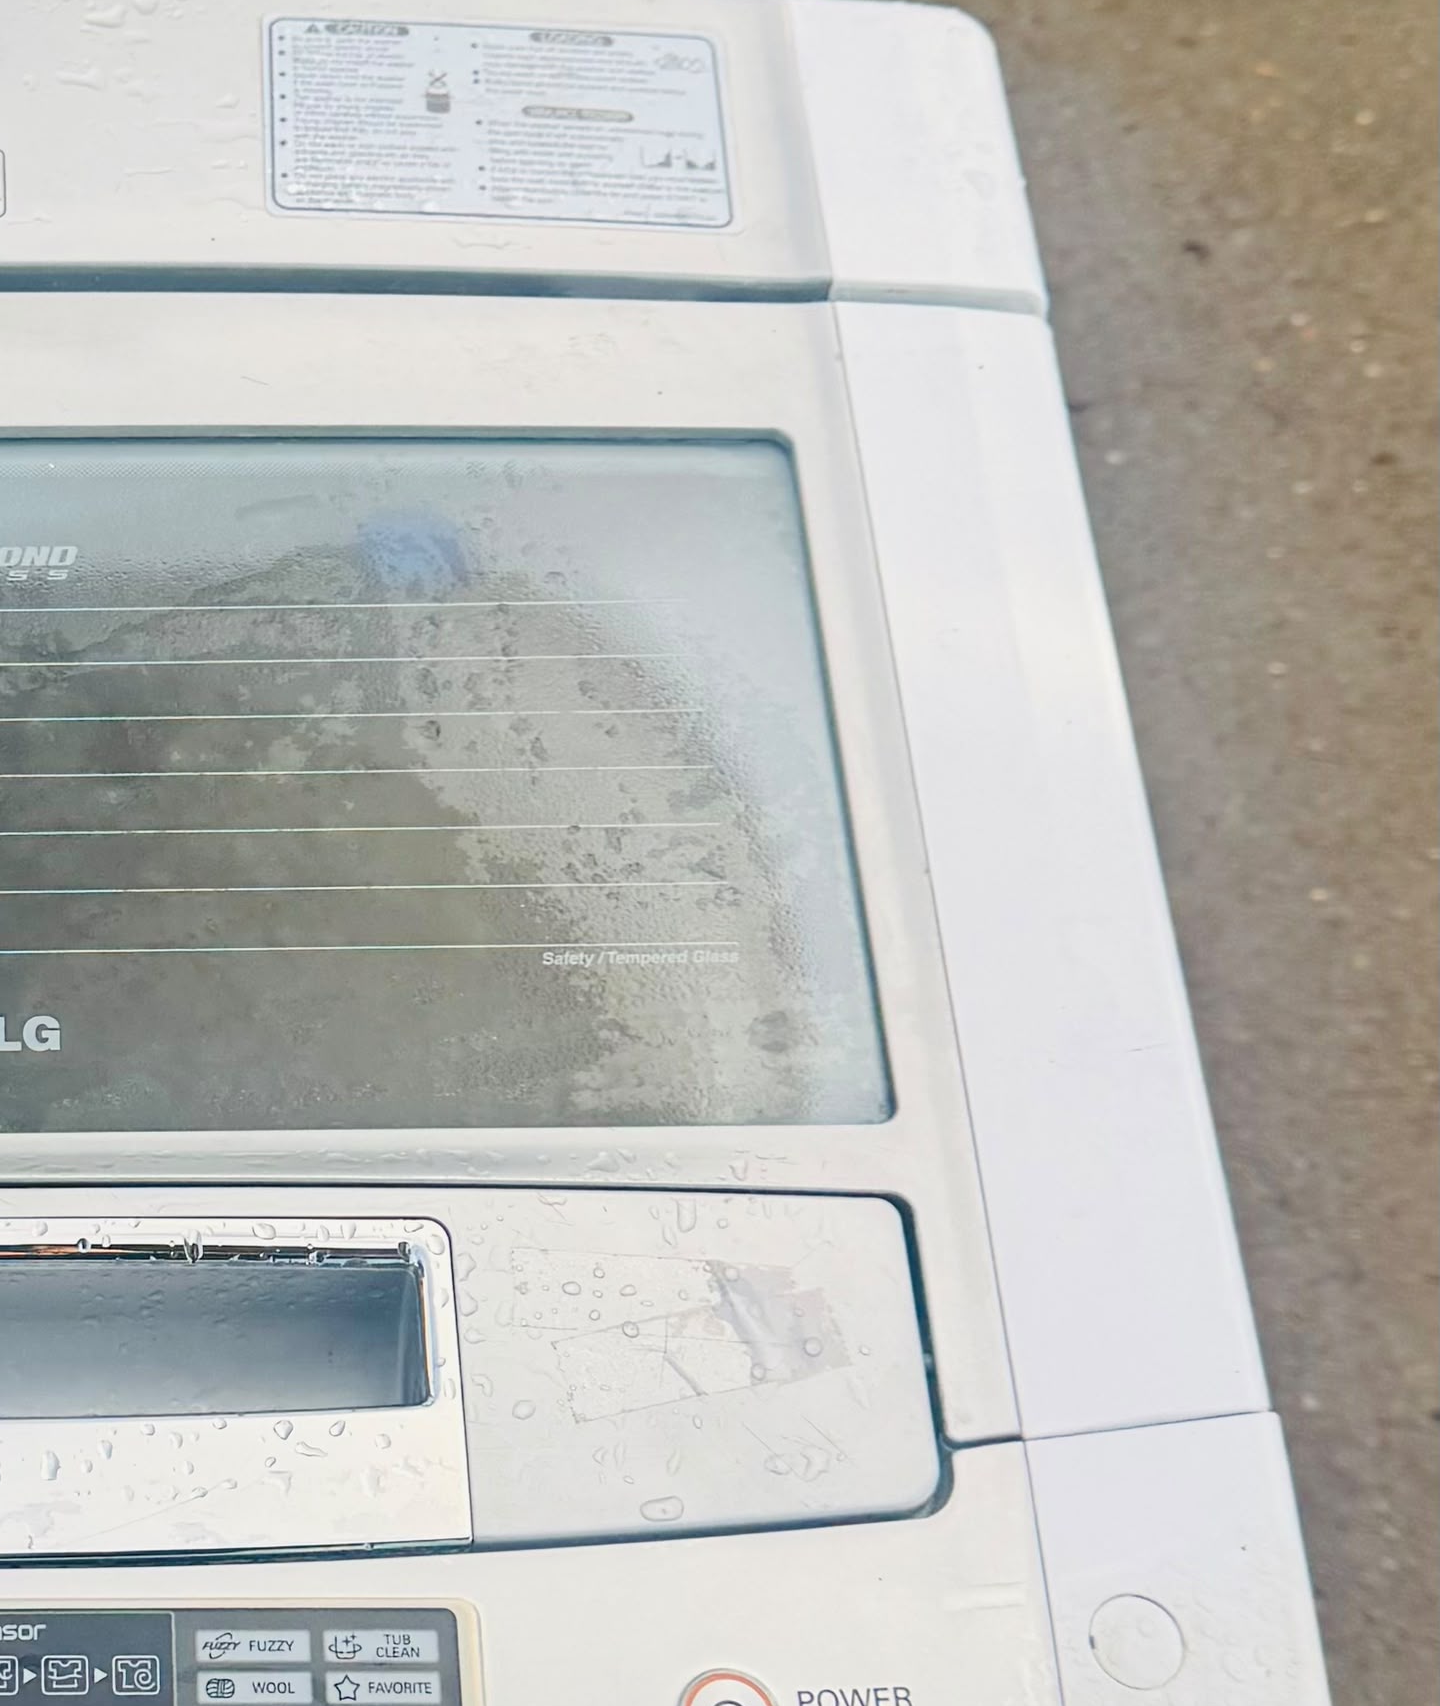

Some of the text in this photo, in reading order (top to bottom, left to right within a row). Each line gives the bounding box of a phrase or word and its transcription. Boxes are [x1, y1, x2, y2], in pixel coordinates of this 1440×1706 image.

[542, 951, 595, 968] Safety
[693, 950, 740, 964] Glass
[249, 1640, 295, 1652] FUZZY
[384, 1634, 411, 1645] TUB
[376, 1647, 421, 1658] CLEAN
[252, 1681, 296, 1695] WOOL
[368, 1681, 433, 1695] FAVORITE
